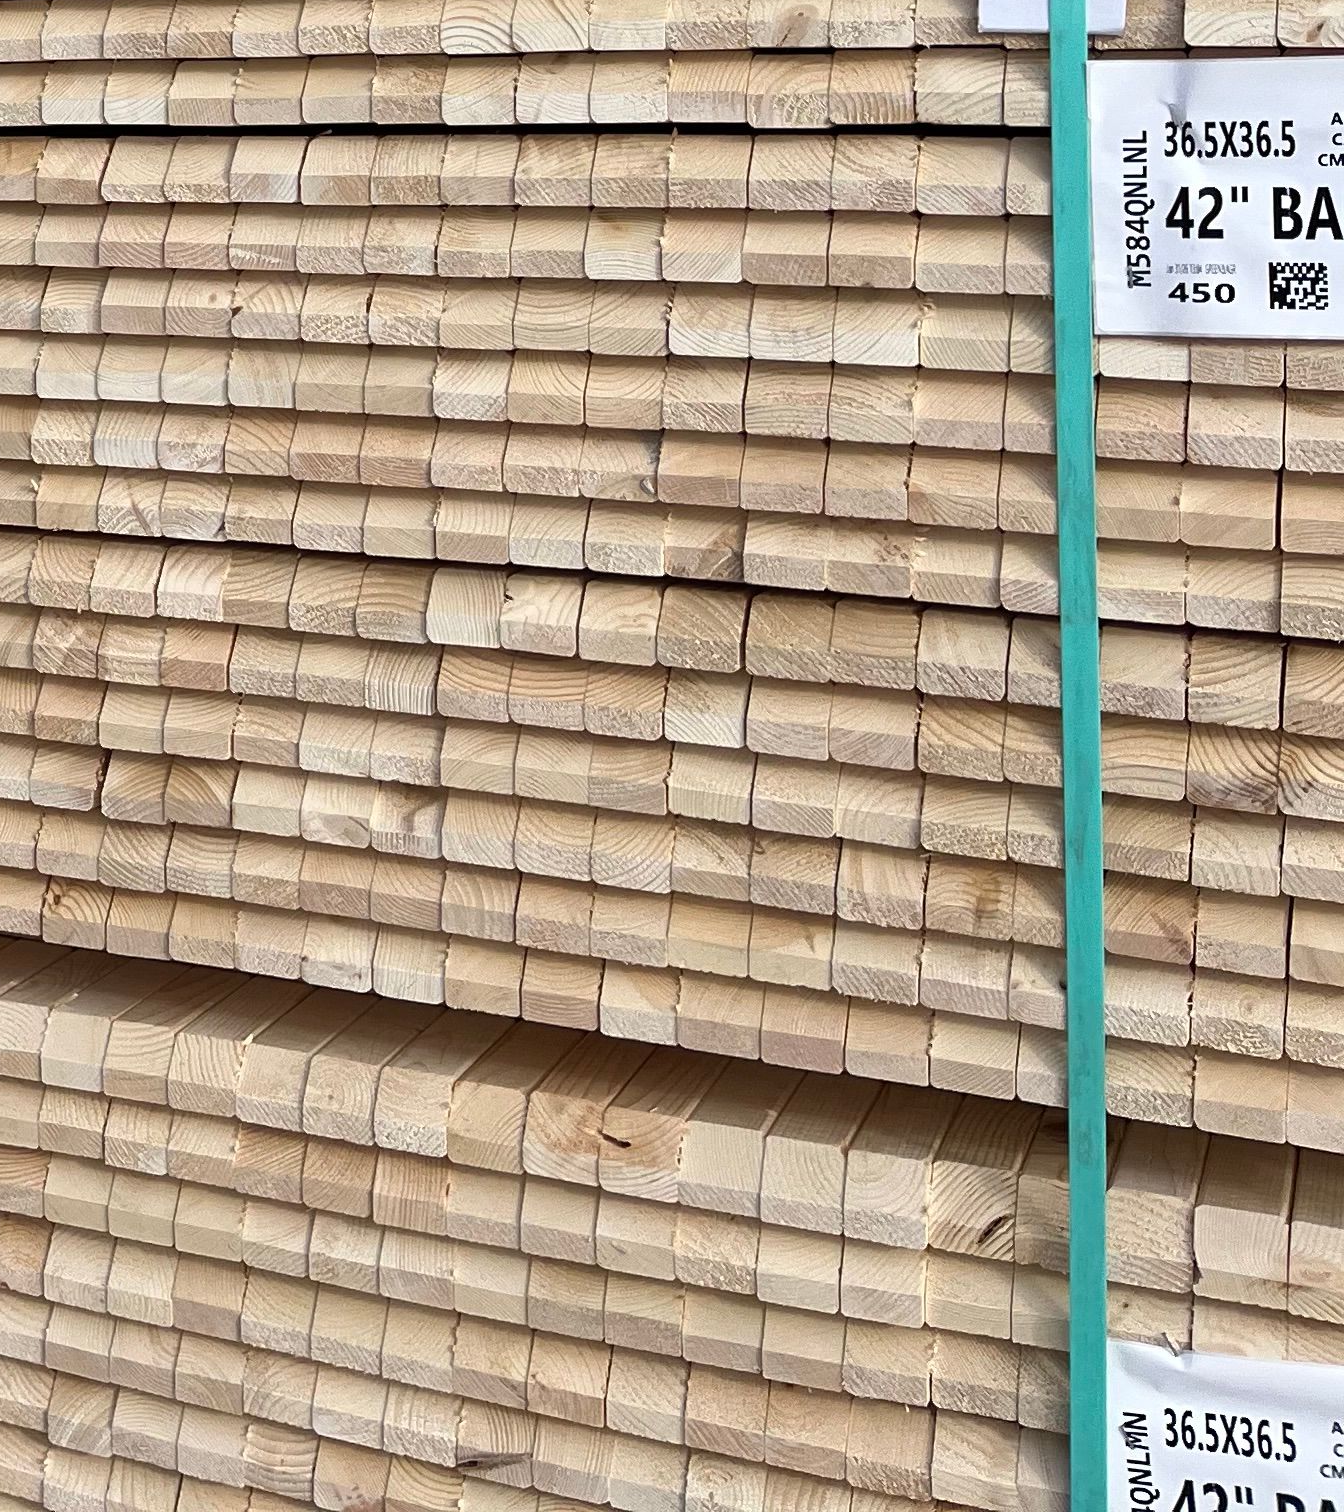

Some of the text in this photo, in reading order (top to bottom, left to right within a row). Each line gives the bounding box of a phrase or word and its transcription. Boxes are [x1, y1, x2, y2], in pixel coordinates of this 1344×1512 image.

[1164, 121, 1296, 158] 36.5X36.5
[1123, 130, 1155, 289] M584QNLNL
[1165, 186, 1249, 239] 42"
[1168, 283, 1236, 303] 450
[1163, 1407, 1297, 1463] 36.5X36.5
